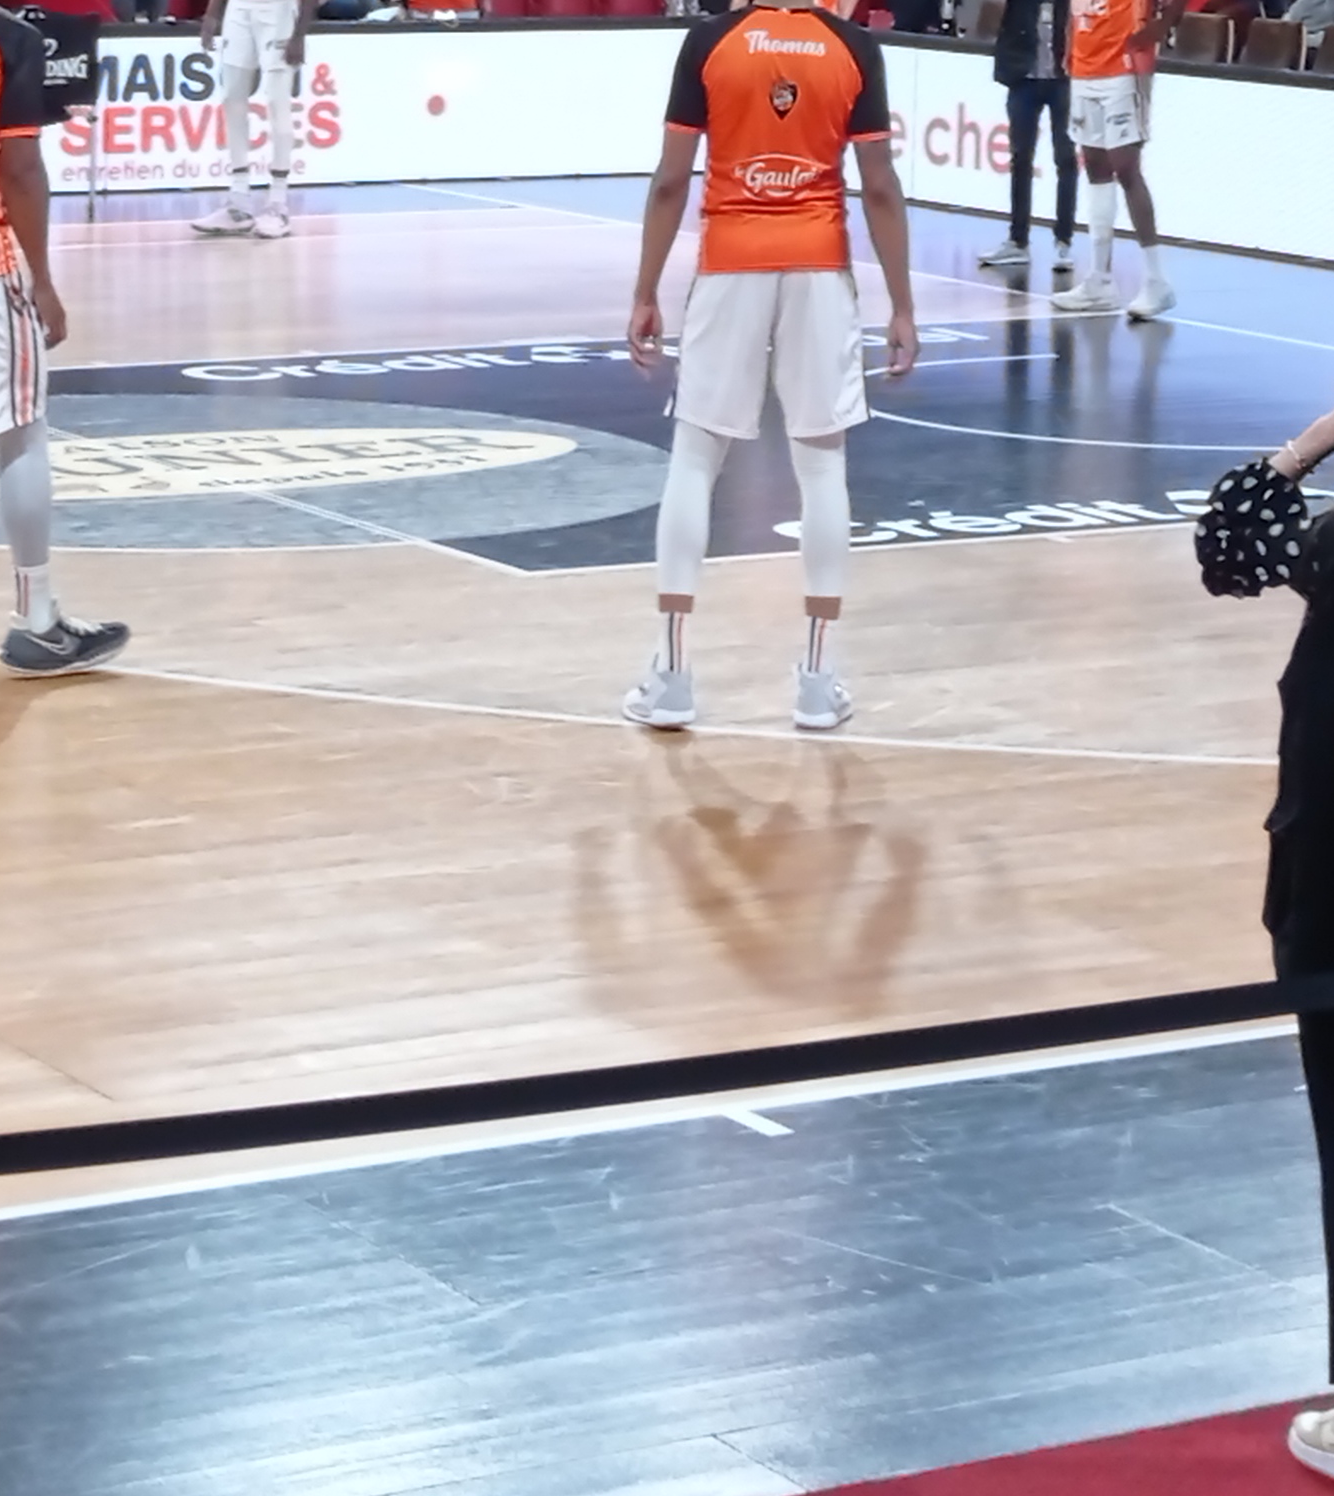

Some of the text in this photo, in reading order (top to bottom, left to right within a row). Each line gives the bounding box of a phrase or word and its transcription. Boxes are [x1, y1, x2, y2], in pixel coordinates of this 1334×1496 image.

[744, 29, 827, 57] Thomas
[45, 53, 89, 80] DING
[97, 52, 337, 102] MAIS &
[60, 101, 342, 156] SERVICS
[61, 158, 165, 182] enretien
[172, 157, 202, 179] du
[745, 162, 819, 194] Gauloi
[180, 349, 533, 382] Crédit
